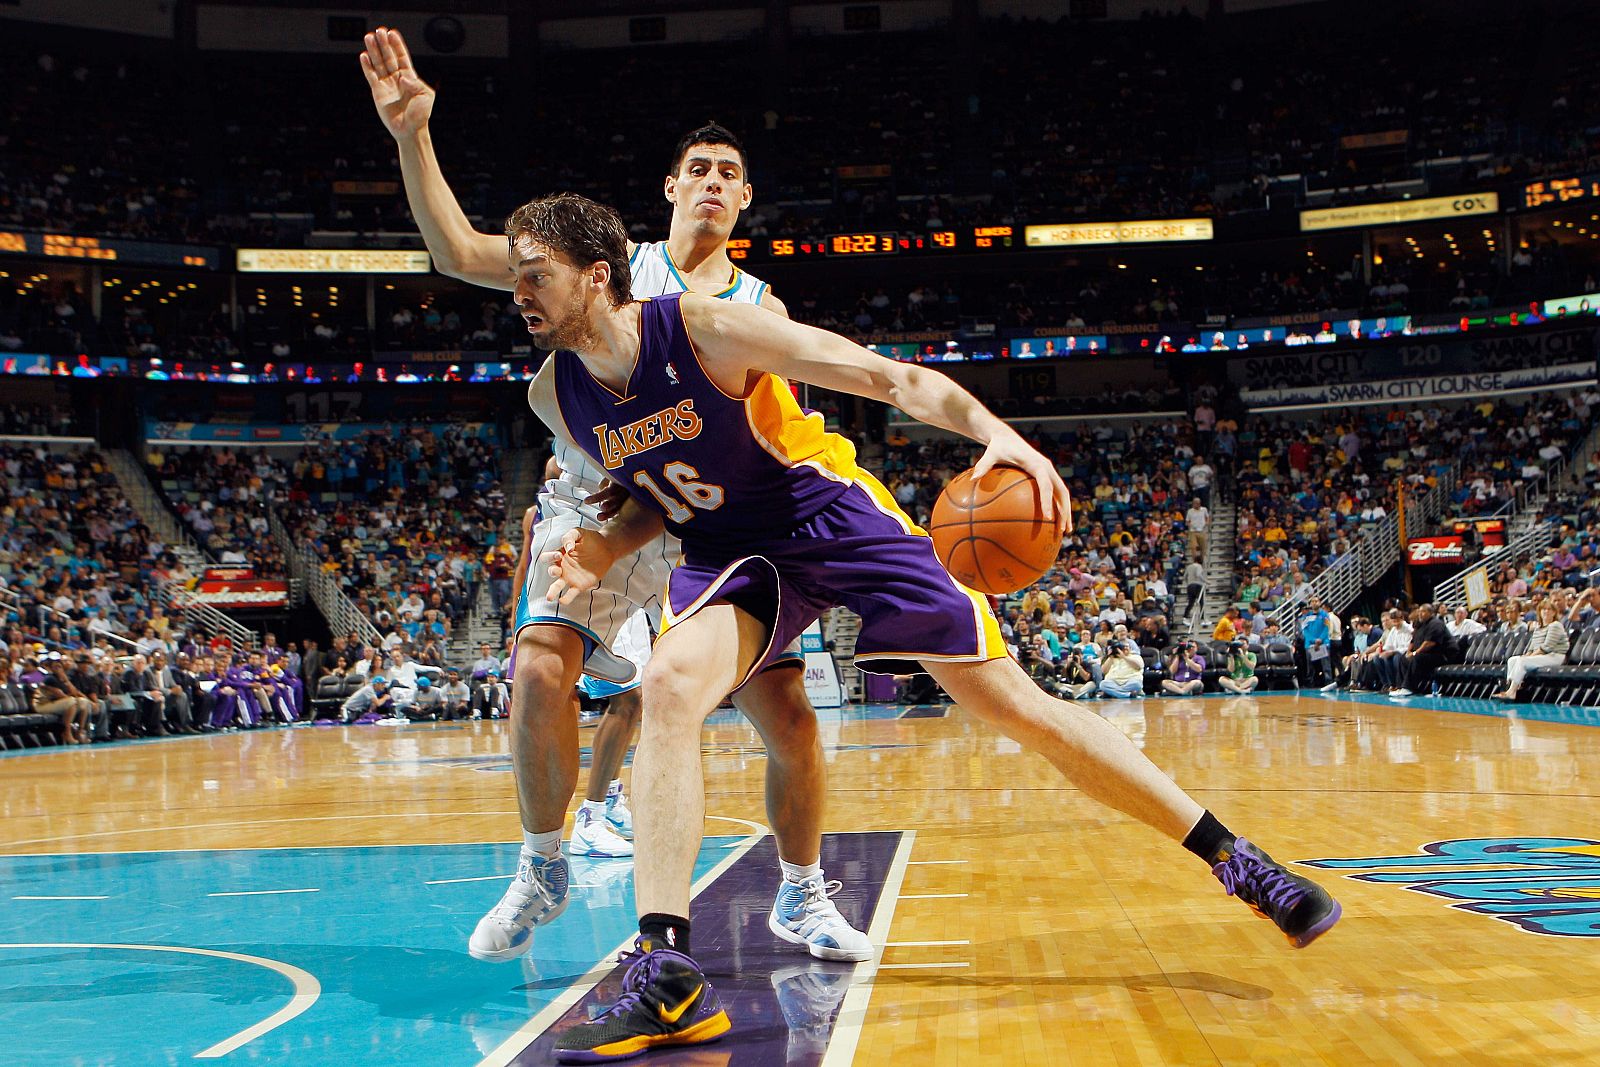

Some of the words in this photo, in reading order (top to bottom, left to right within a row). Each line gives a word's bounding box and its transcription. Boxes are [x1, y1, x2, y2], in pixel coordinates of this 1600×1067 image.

[882, 237, 893, 252] 3
[933, 232, 955, 247] 43
[1051, 227, 1119, 241] HORNBECK
[1120, 225, 1186, 239] OFFSHORE
[772, 240, 795, 255] 56
[1034, 325, 1101, 337] COMMERCIAL
[1102, 323, 1159, 335] INSURANCE
[1245, 357, 1313, 379] SWARM
[1317, 351, 1368, 373] CITY
[1397, 344, 1442, 367] 120
[1329, 383, 1384, 402] SWARM
[1387, 378, 1427, 398] CITY
[1431, 374, 1502, 394] LOUNGE
[285, 391, 362, 423] 117
[593, 399, 703, 470] LAKERS
[633, 461, 725, 524] 16
